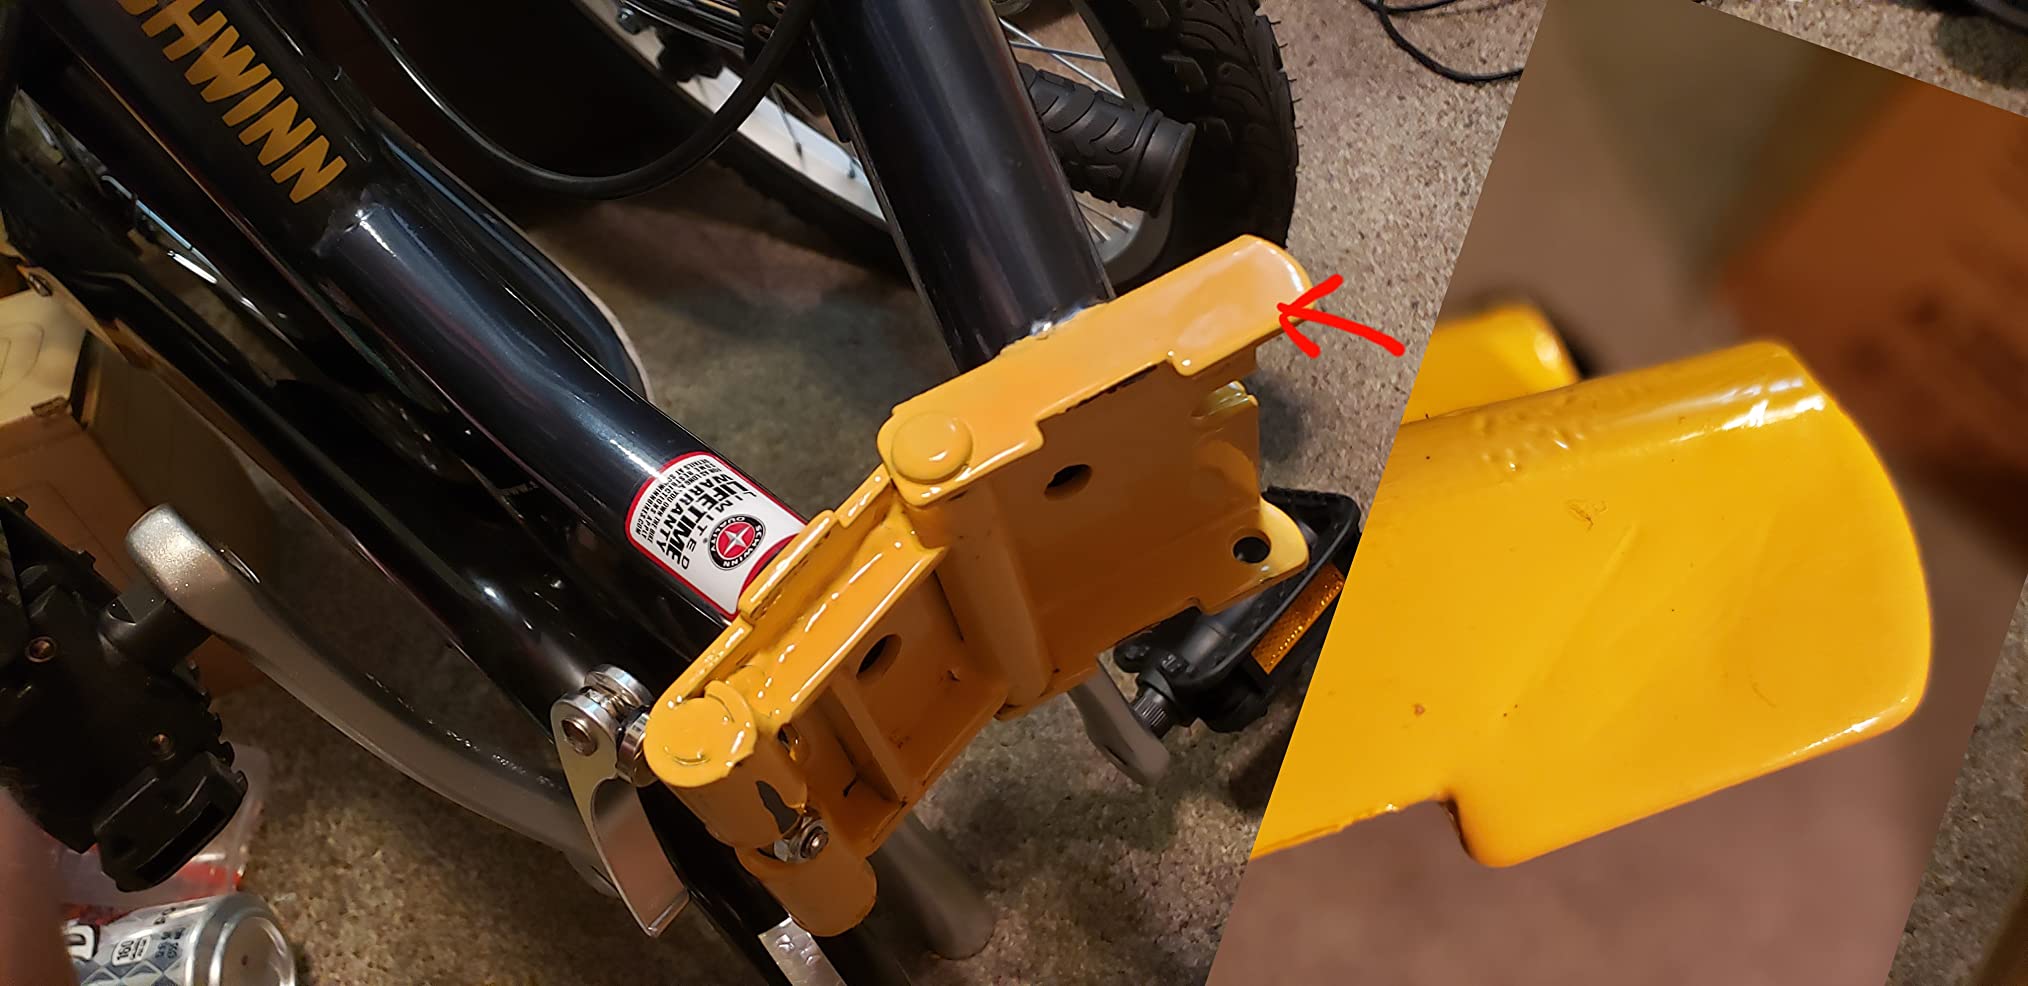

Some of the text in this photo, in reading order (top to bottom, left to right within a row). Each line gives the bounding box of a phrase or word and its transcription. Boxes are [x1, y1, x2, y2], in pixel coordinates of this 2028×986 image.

[116, 0, 347, 204] HWINN
[650, 471, 693, 514] RESTRICTIONS
[684, 473, 702, 485] LONG
[656, 473, 734, 553] WARRANTY
[657, 502, 669, 517] OWN
[667, 491, 680, 503] YOU
[641, 515, 653, 539] APPLY
[647, 529, 656, 543] BIKE
[651, 517, 661, 529] THE
[666, 481, 749, 564] LIFETIME
[681, 492, 757, 569] LIMITED
[711, 516, 746, 551] QUALITY
[723, 525, 763, 567] SCHWINN
